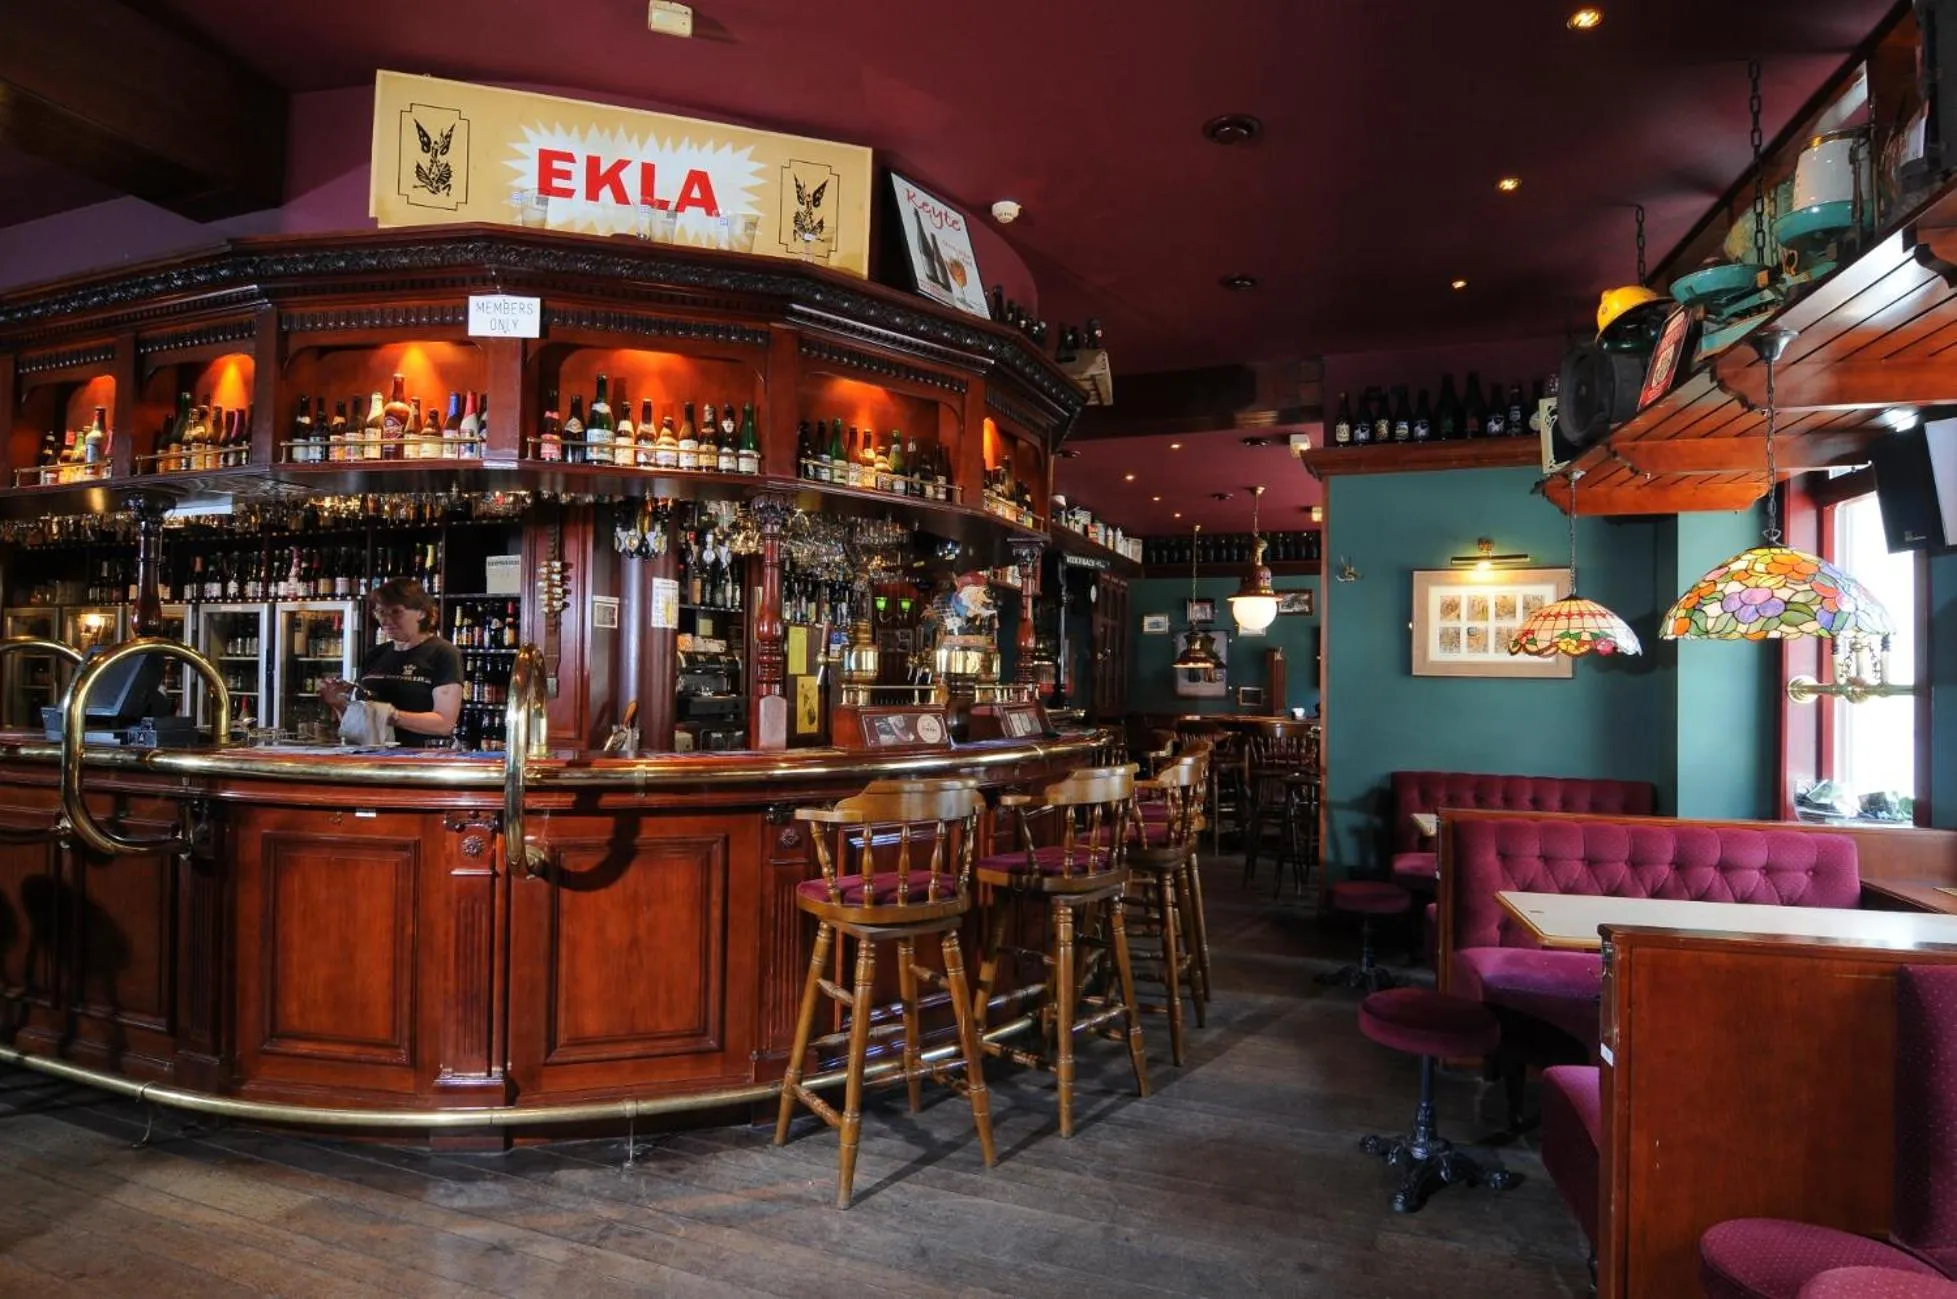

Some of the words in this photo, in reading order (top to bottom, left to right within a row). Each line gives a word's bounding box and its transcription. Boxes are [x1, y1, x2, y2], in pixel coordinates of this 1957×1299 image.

[537, 147, 720, 218] EKLA
[903, 187, 962, 232] Keyte
[475, 301, 534, 316] MEMBERS
[489, 318, 519, 332] ONLY
